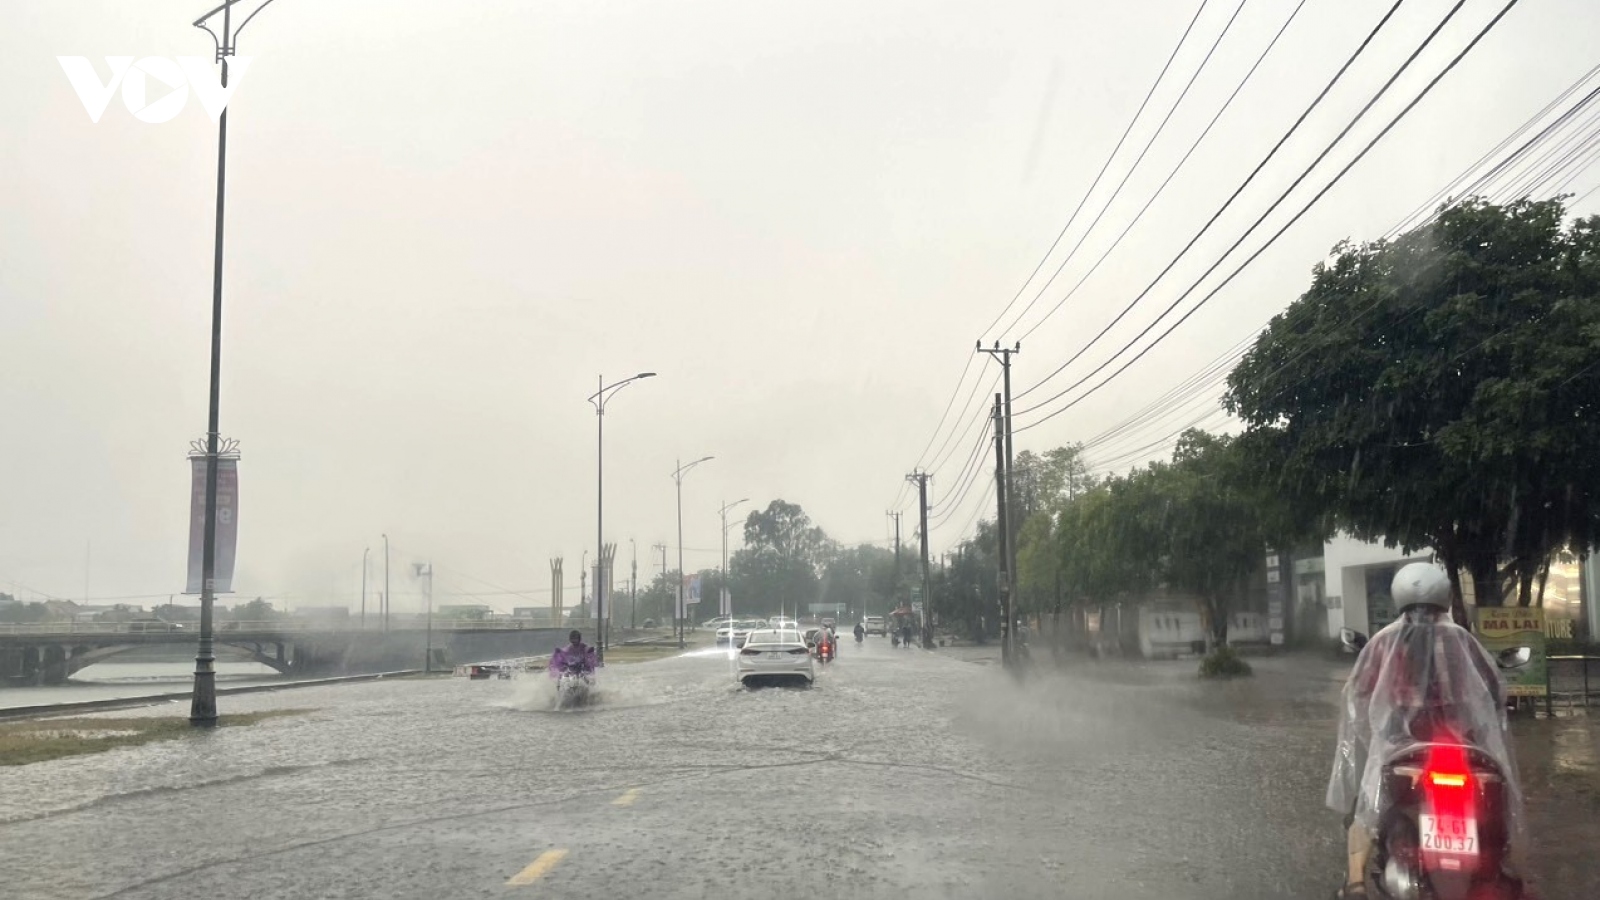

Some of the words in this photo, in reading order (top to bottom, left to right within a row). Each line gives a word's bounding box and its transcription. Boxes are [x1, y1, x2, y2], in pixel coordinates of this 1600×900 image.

[1483, 620, 1509, 630] MA
[1513, 620, 1540, 630] LAI
[1423, 833, 1475, 852] 200.37
